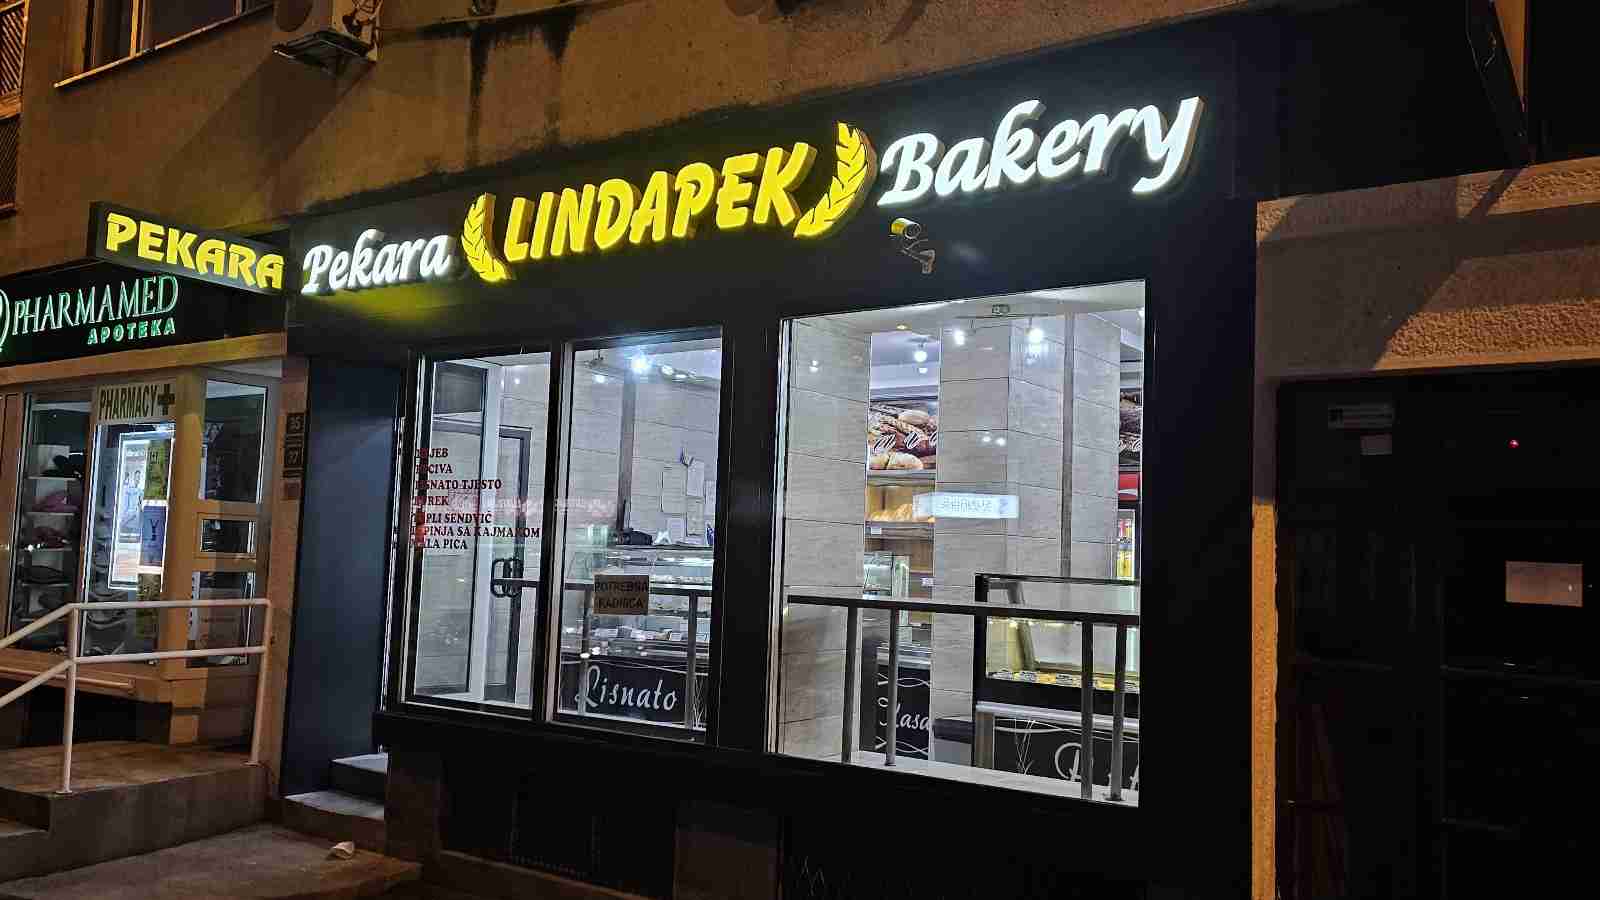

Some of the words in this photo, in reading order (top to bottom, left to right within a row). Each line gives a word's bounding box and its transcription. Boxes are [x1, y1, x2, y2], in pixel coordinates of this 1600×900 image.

[301, 228, 454, 296] Pekara
[503, 141, 811, 263] LINDAPEK
[877, 96, 1203, 207] Bakery
[106, 212, 284, 290] PEKARA
[12, 274, 179, 336] PHARMAMED
[87, 317, 177, 345] APOTEKA
[99, 384, 158, 420] PHARMACY
[575, 665, 677, 711] Lisnato
